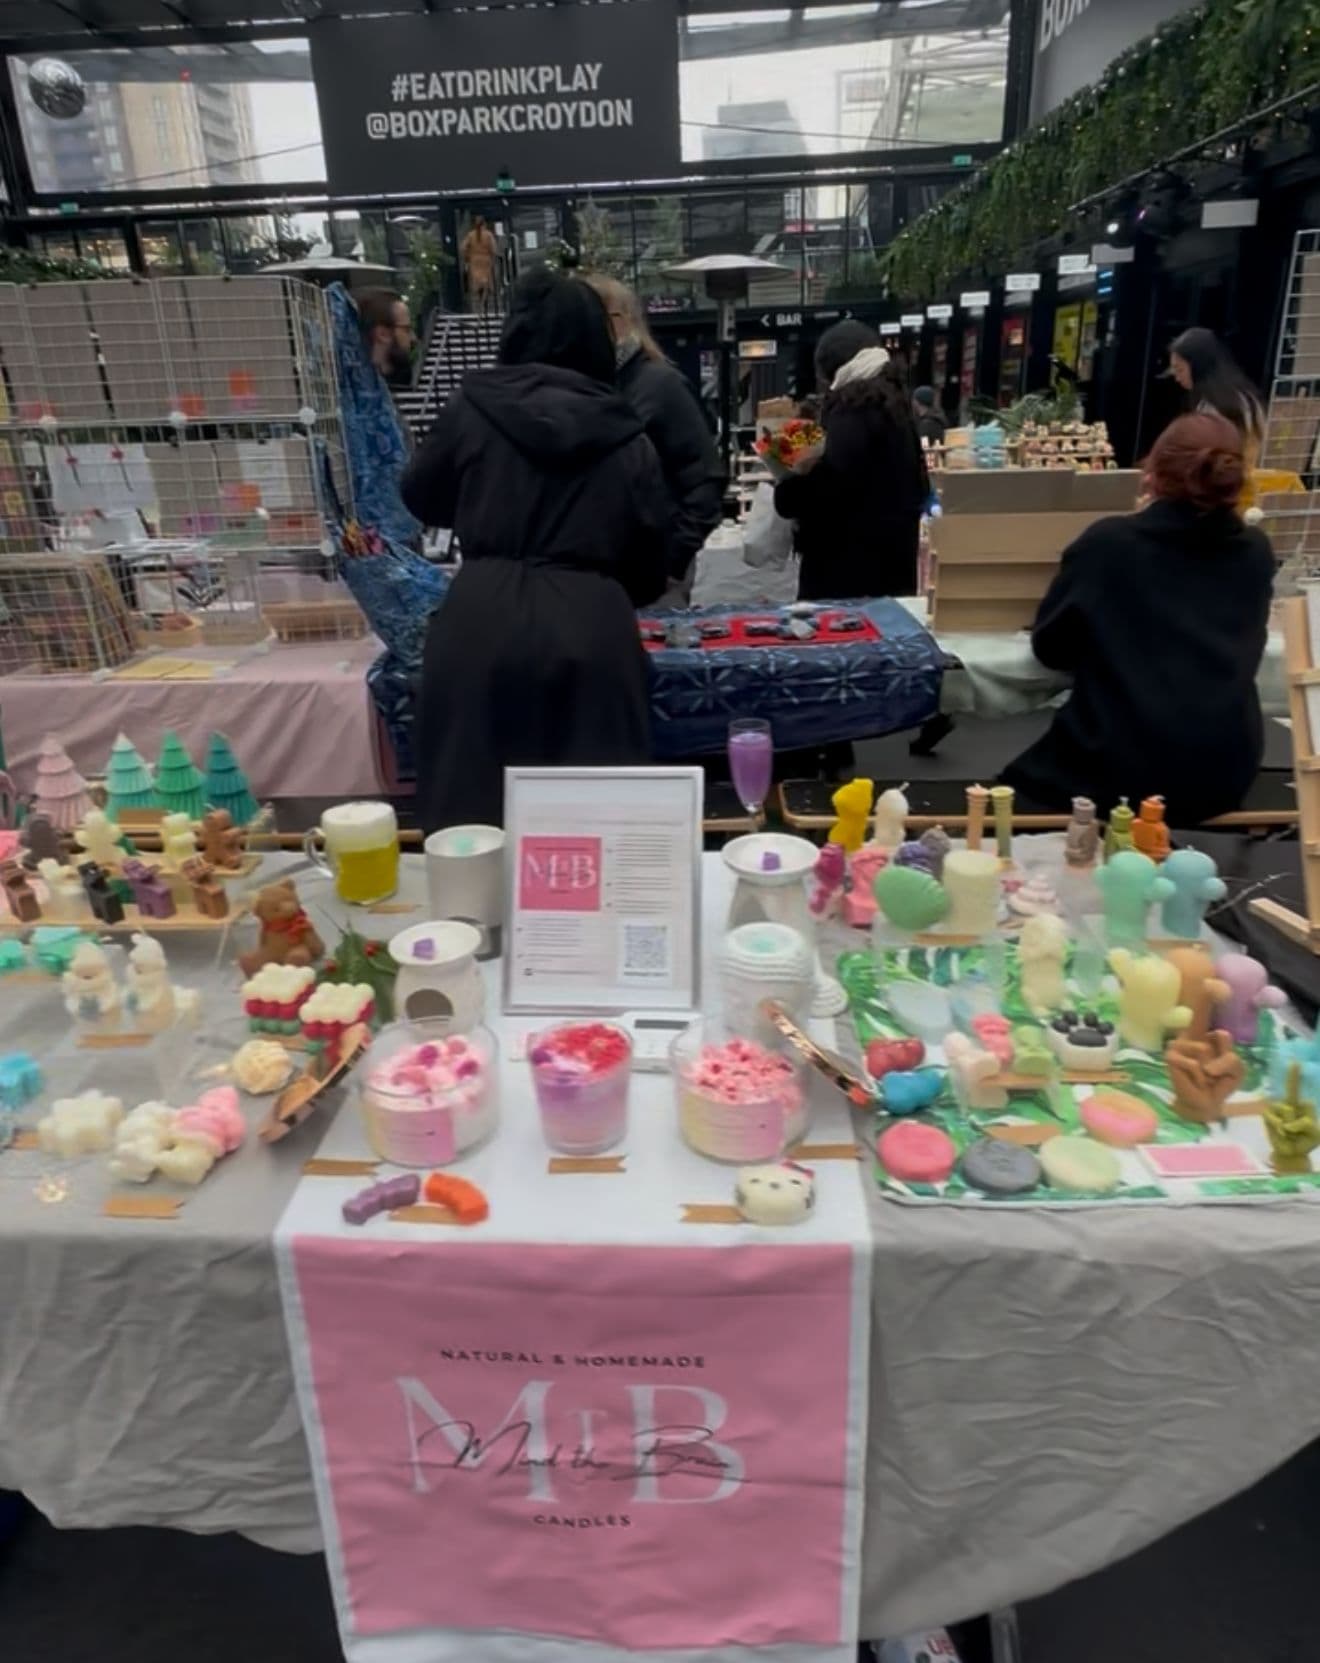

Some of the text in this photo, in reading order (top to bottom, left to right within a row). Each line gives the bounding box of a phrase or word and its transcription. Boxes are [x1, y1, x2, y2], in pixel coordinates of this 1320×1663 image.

[391, 63, 602, 102] #EATDRINKPLAY
[366, 98, 633, 139] @BOXPARKCROYDON
[776, 313, 802, 326] BAR
[440, 1349, 705, 1368] NATURAL & HOMEMADE
[533, 1514, 632, 1528] CANDLES
